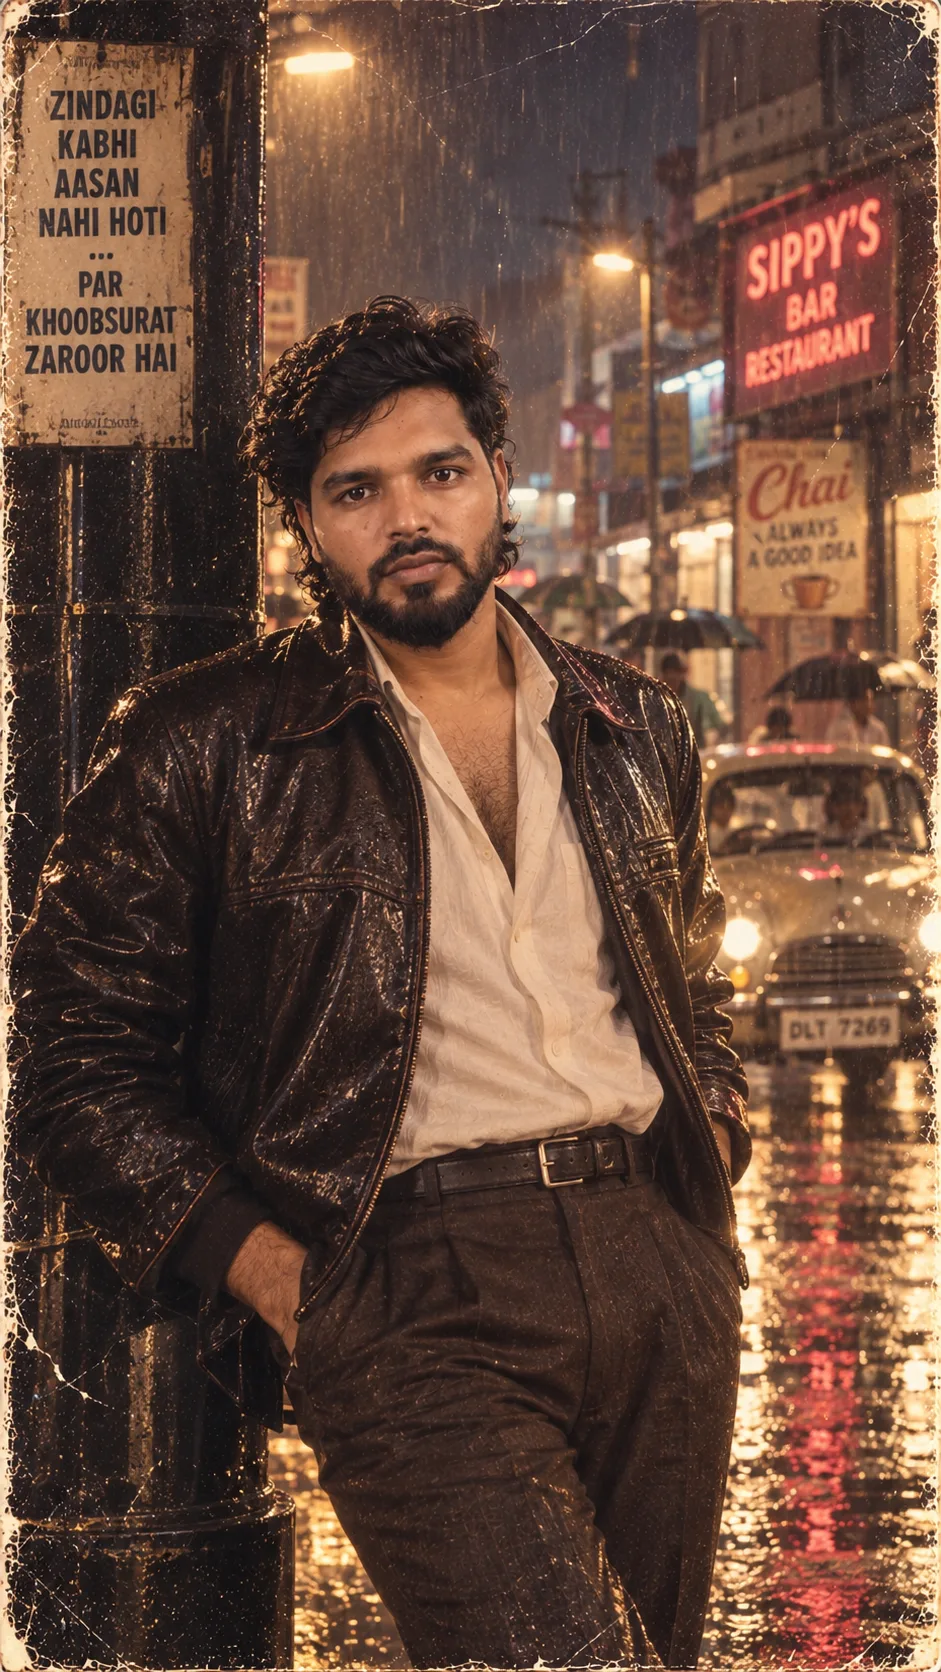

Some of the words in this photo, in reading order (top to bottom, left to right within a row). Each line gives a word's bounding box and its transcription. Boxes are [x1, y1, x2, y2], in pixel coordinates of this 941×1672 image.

[50, 89, 156, 121] ZINDAGI
[58, 129, 137, 160] KABHI
[54, 168, 139, 198] AASAN
[39, 207, 99, 238] NAHI
[109, 206, 167, 237] HOTI
[746, 197, 881, 300] SIPPY'S
[78, 271, 123, 297] PAR
[26, 306, 177, 336] KHOOBSURAT
[786, 281, 837, 332] BAR
[24, 344, 125, 375] ZAROOR
[135, 343, 177, 373] HAI
[745, 313, 875, 388] RESTAURANT
[747, 460, 853, 521] Chai
[769, 517, 838, 542] ALWAYS
[747, 551, 759, 568] A
[764, 545, 812, 567] GOOD
[818, 542, 858, 562] IDEA
[789, 1020, 826, 1039] DLT
[839, 1017, 891, 1037] 7269
